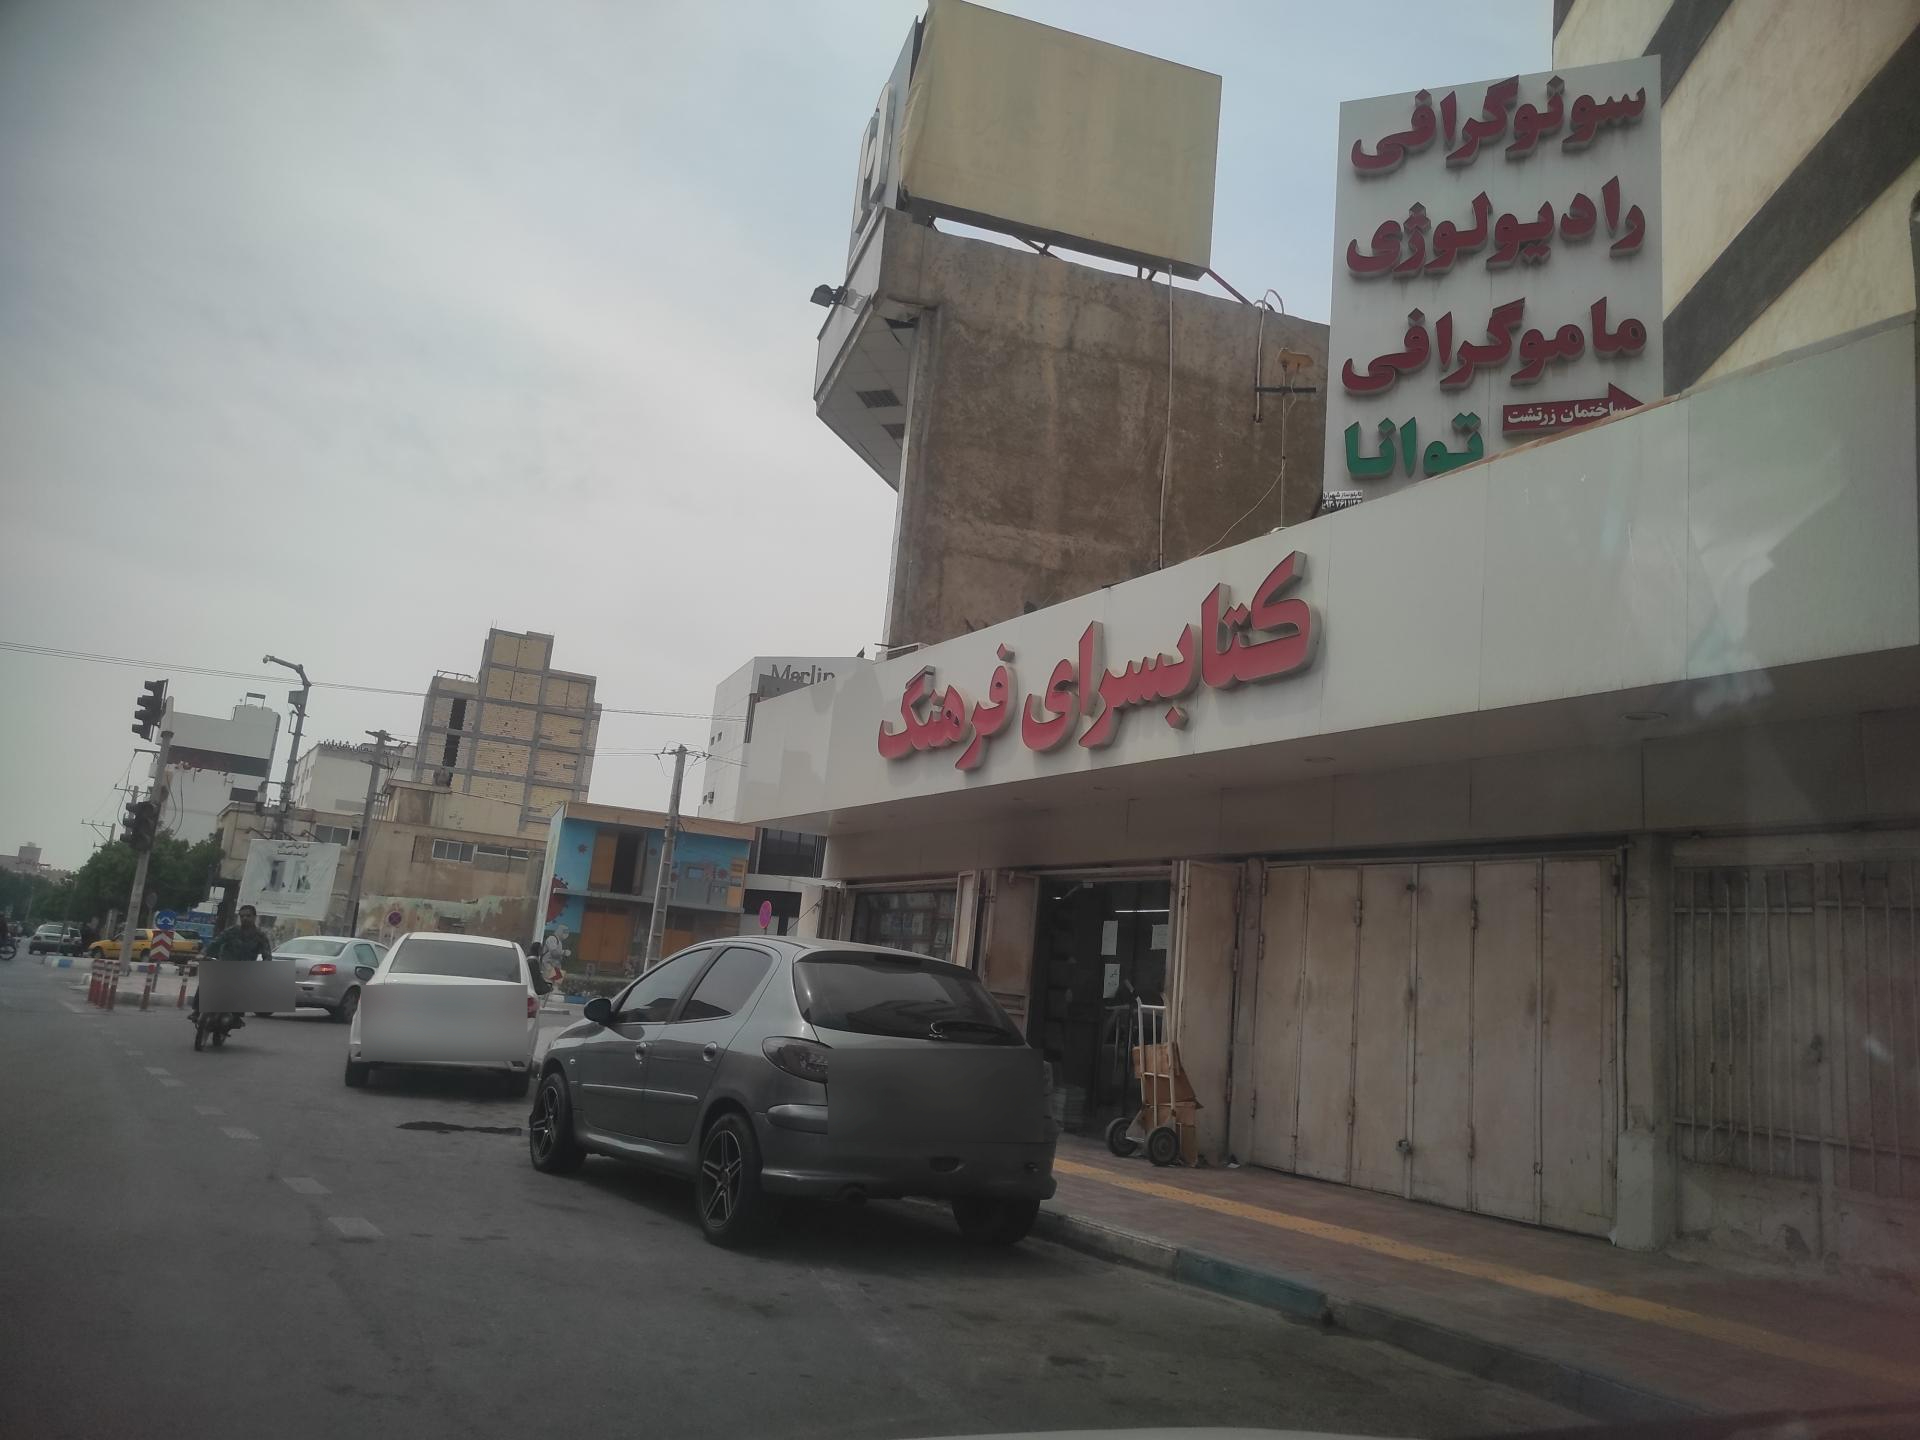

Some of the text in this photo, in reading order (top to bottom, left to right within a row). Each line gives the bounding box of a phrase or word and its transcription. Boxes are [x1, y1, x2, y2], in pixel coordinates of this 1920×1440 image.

[1351, 75, 1646, 173] سونوگرافی
[1347, 175, 1646, 279] رادیولوژی
[1342, 297, 1648, 393] ماموگرافی
[1344, 411, 1484, 478] توانا
[1507, 407, 1556, 426] زرتشت
[877, 550, 1318, 771] کتابسرای فرهنگ
